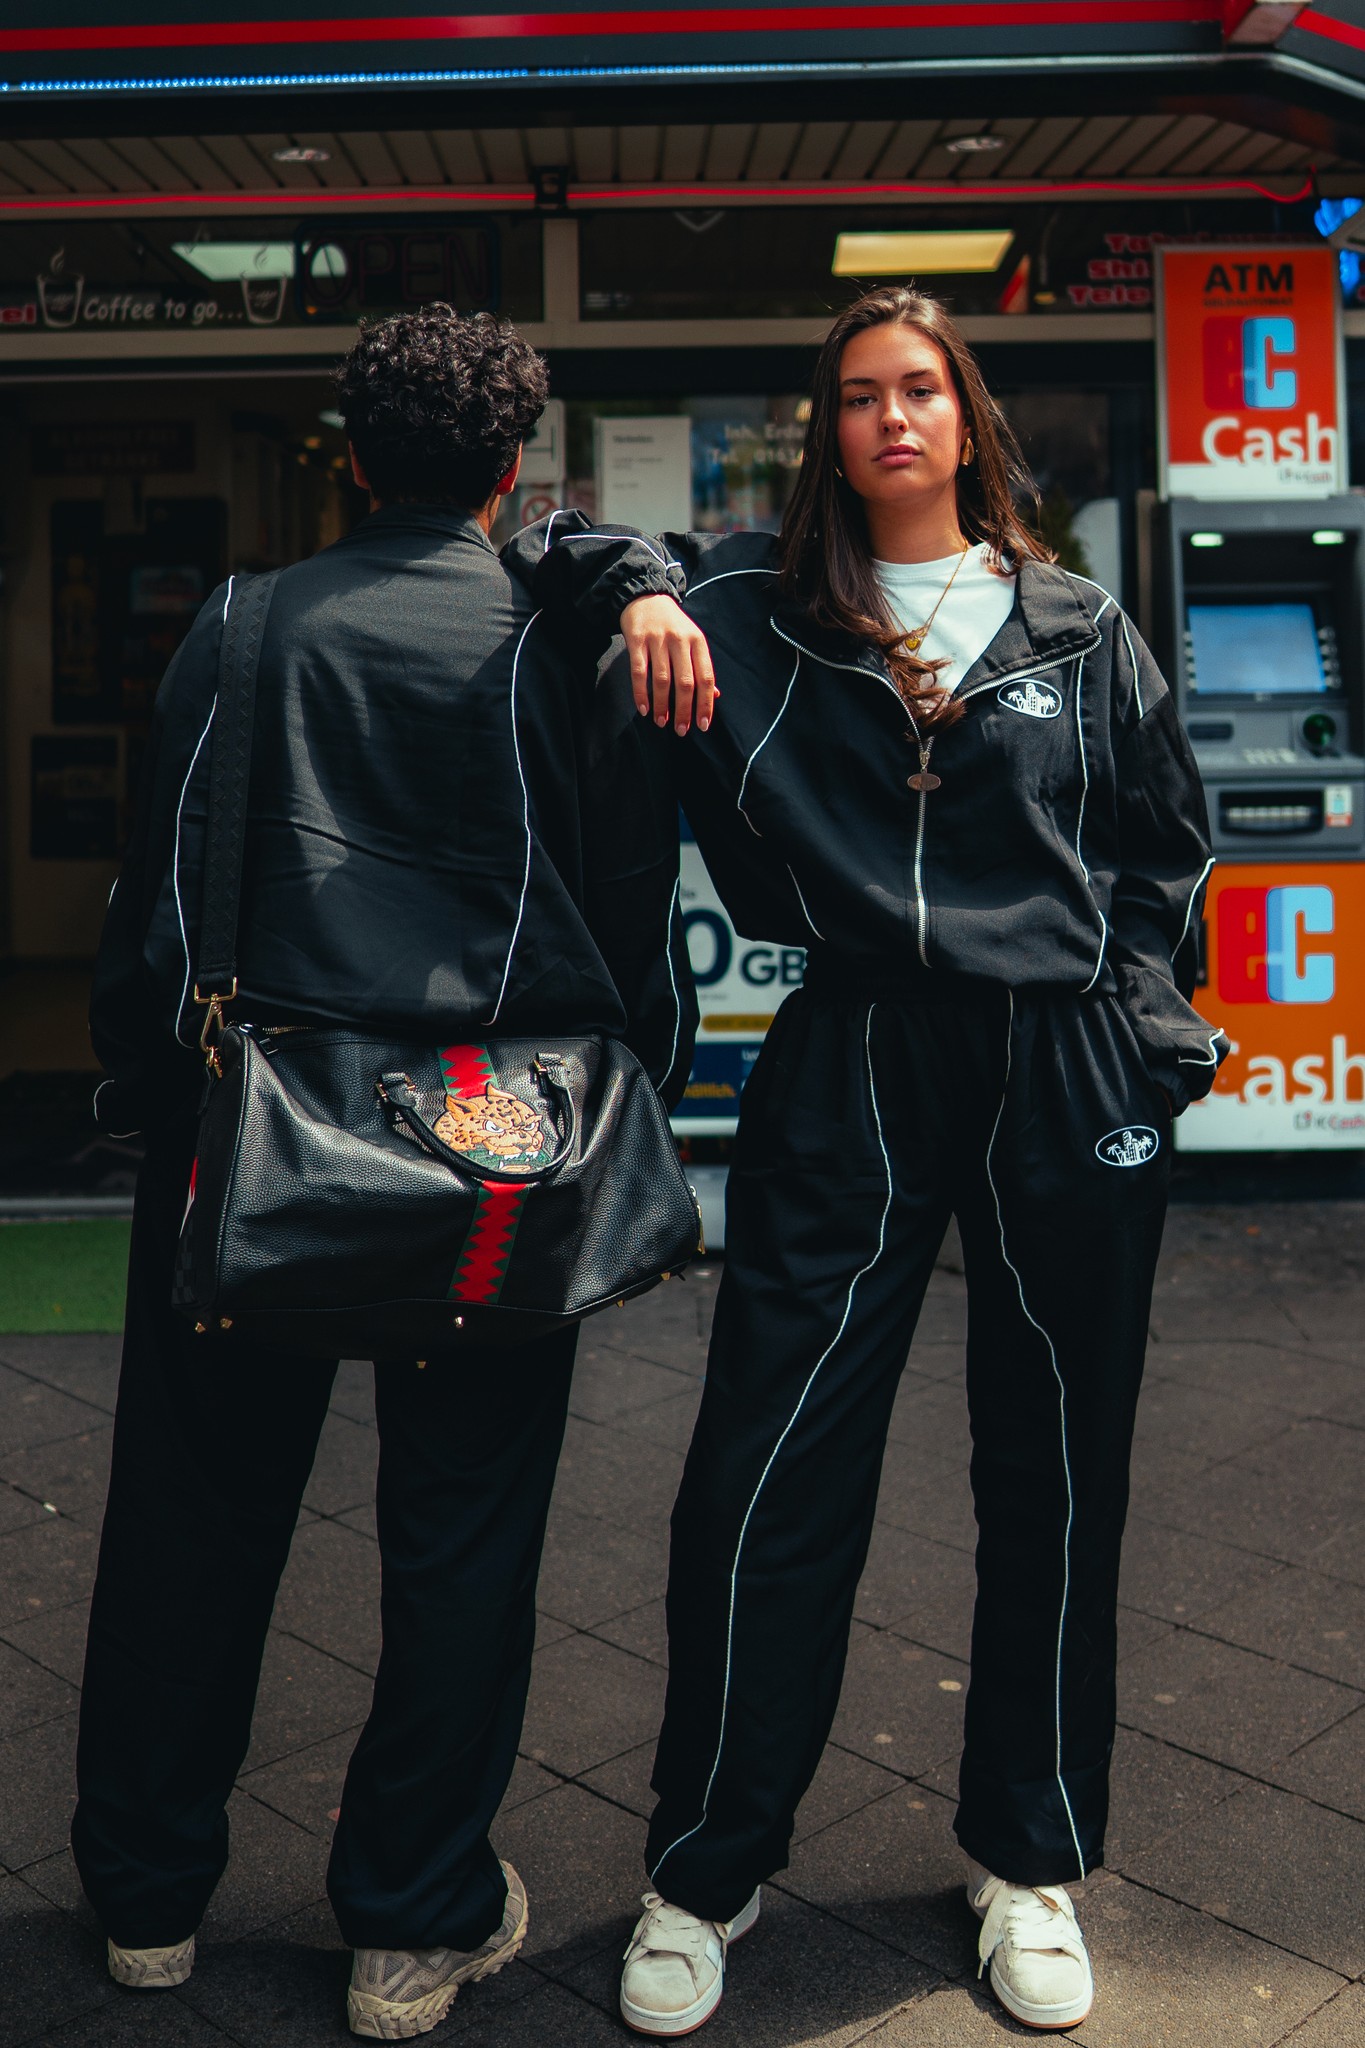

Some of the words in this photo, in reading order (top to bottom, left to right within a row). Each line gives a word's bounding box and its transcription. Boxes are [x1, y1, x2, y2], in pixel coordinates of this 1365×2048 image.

[304, 235, 489, 306] OPEN
[1203, 263, 1294, 293] ATM
[83, 294, 156, 323] Coffee
[164, 298, 187, 320] to
[1202, 413, 1338, 465] Cash
[740, 949, 806, 986] GB
